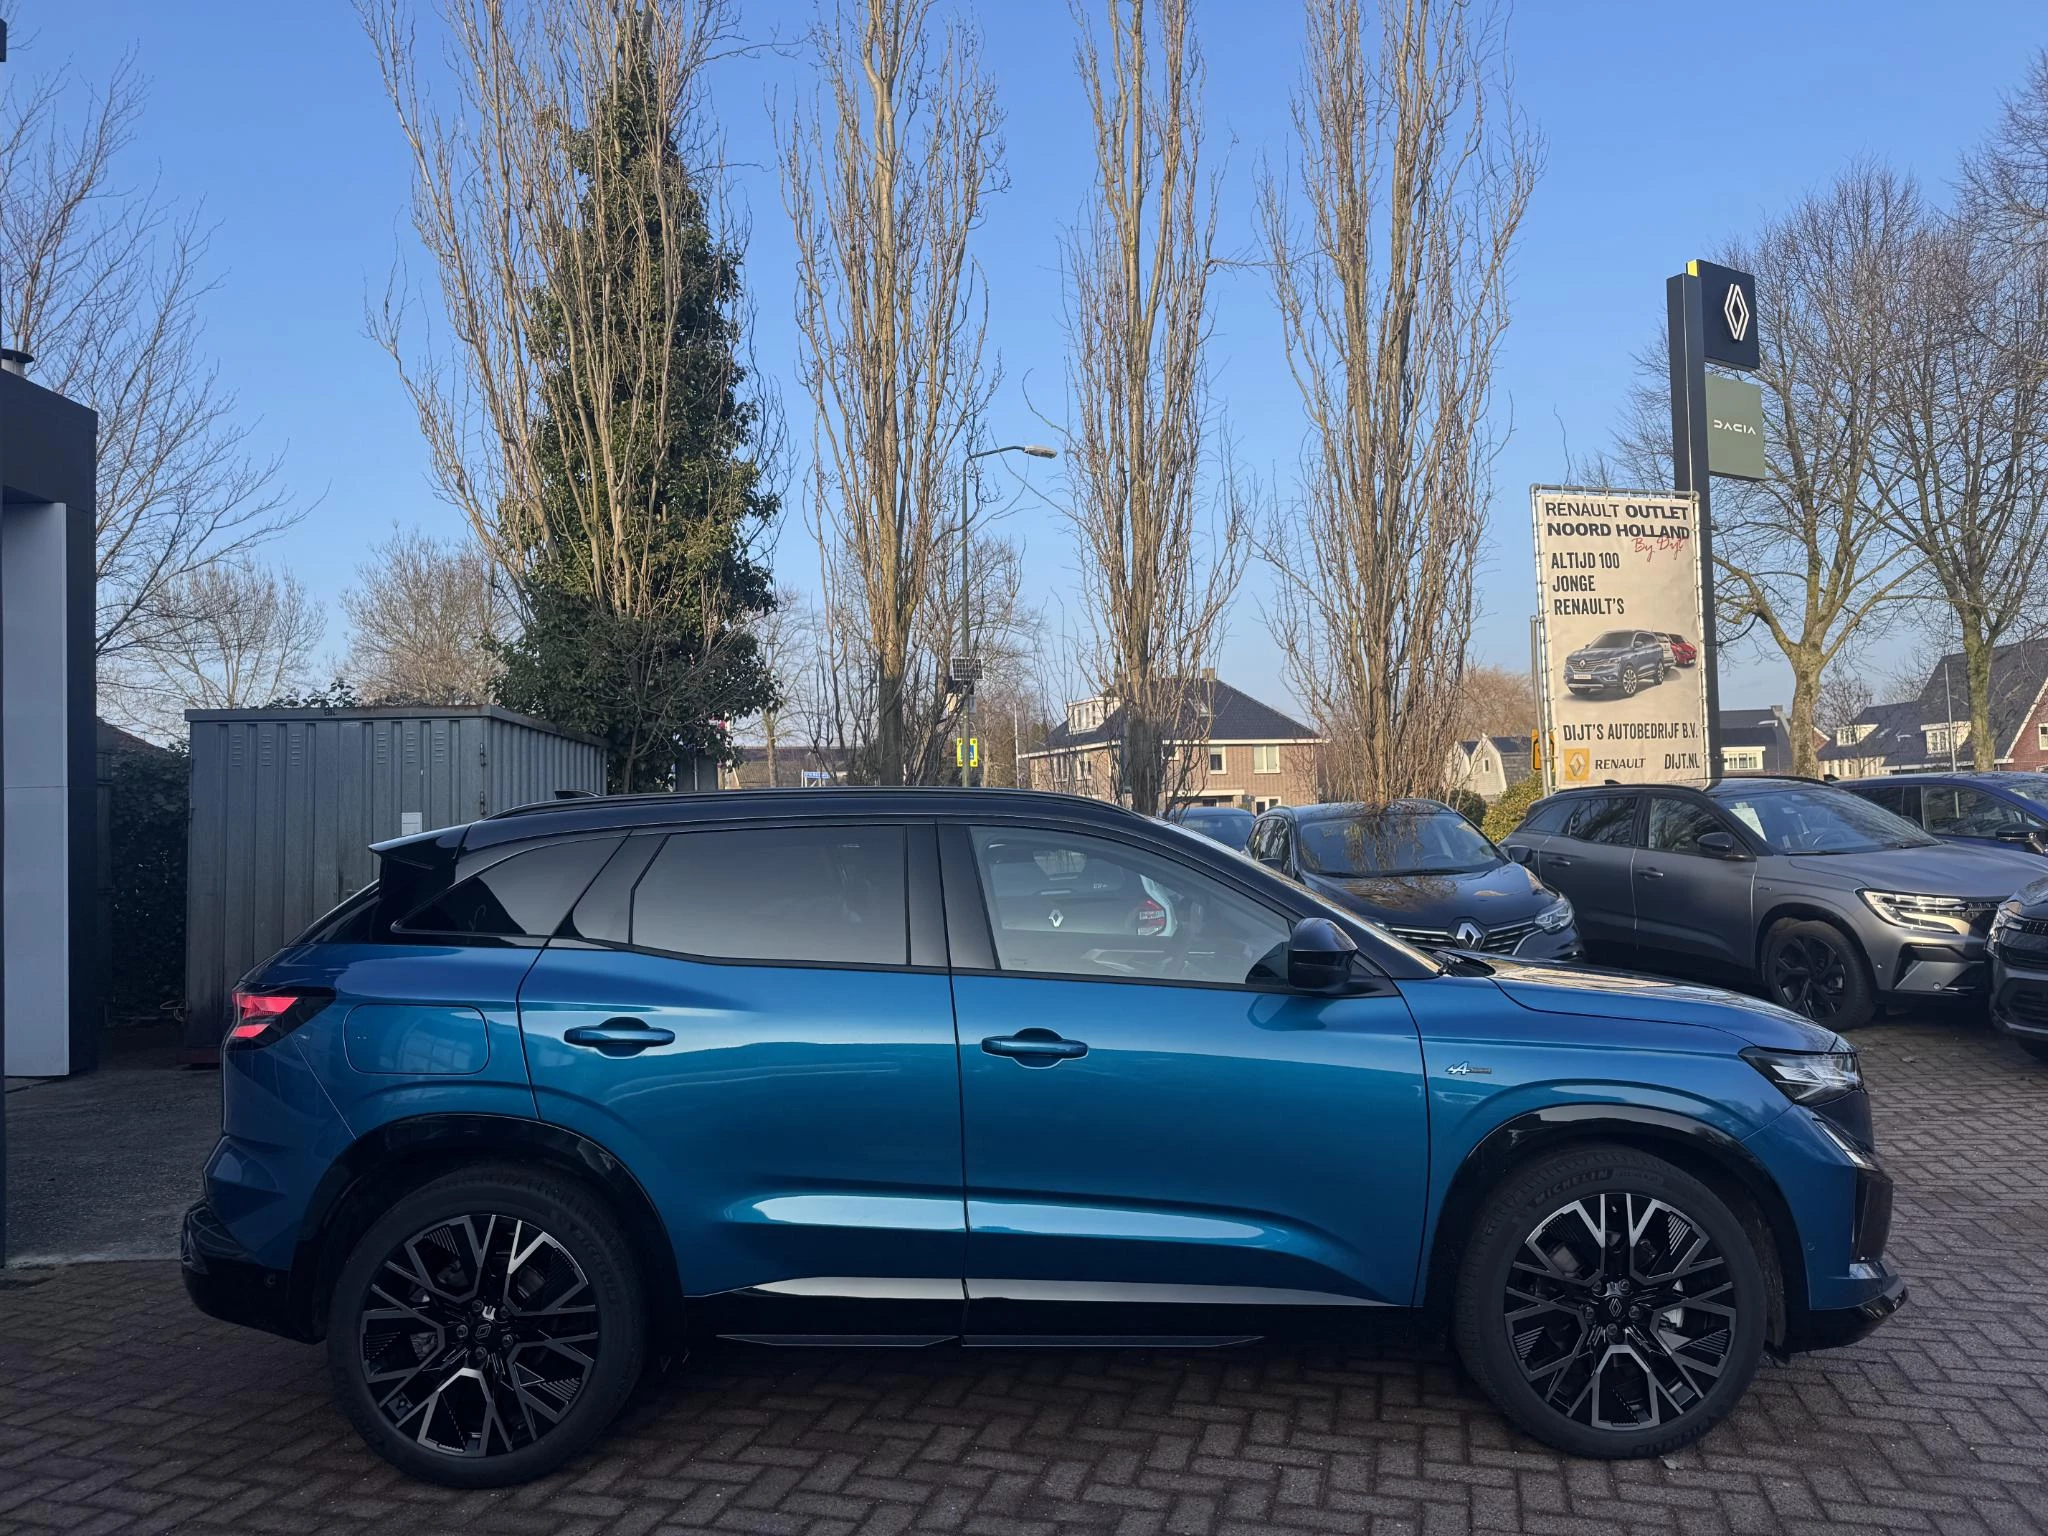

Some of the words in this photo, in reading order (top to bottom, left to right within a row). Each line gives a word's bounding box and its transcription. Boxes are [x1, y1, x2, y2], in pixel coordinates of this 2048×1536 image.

[1713, 419, 1756, 436] DACIA
[1545, 502, 1619, 518] RENAULT
[1625, 504, 1689, 521] OUTLET
[1547, 522, 1611, 537] NOORD
[1616, 524, 1690, 540] HOLLAND
[1631, 537, 1655, 562] By
[1551, 552, 1595, 569] ALTIJD
[1599, 552, 1620, 569] 100
[1552, 575, 1596, 593] JONGE
[1554, 598, 1625, 615] RENAULT'S
[1563, 723, 1603, 741] DIJT'S
[1607, 722, 1680, 740] AUTOBEDRIJF
[1682, 722, 1698, 738] B.V.
[1594, 758, 1646, 770] RENAULT
[1664, 753, 1700, 770] DIJT.NL
[1534, 1169, 1609, 1206] MICHELIN
